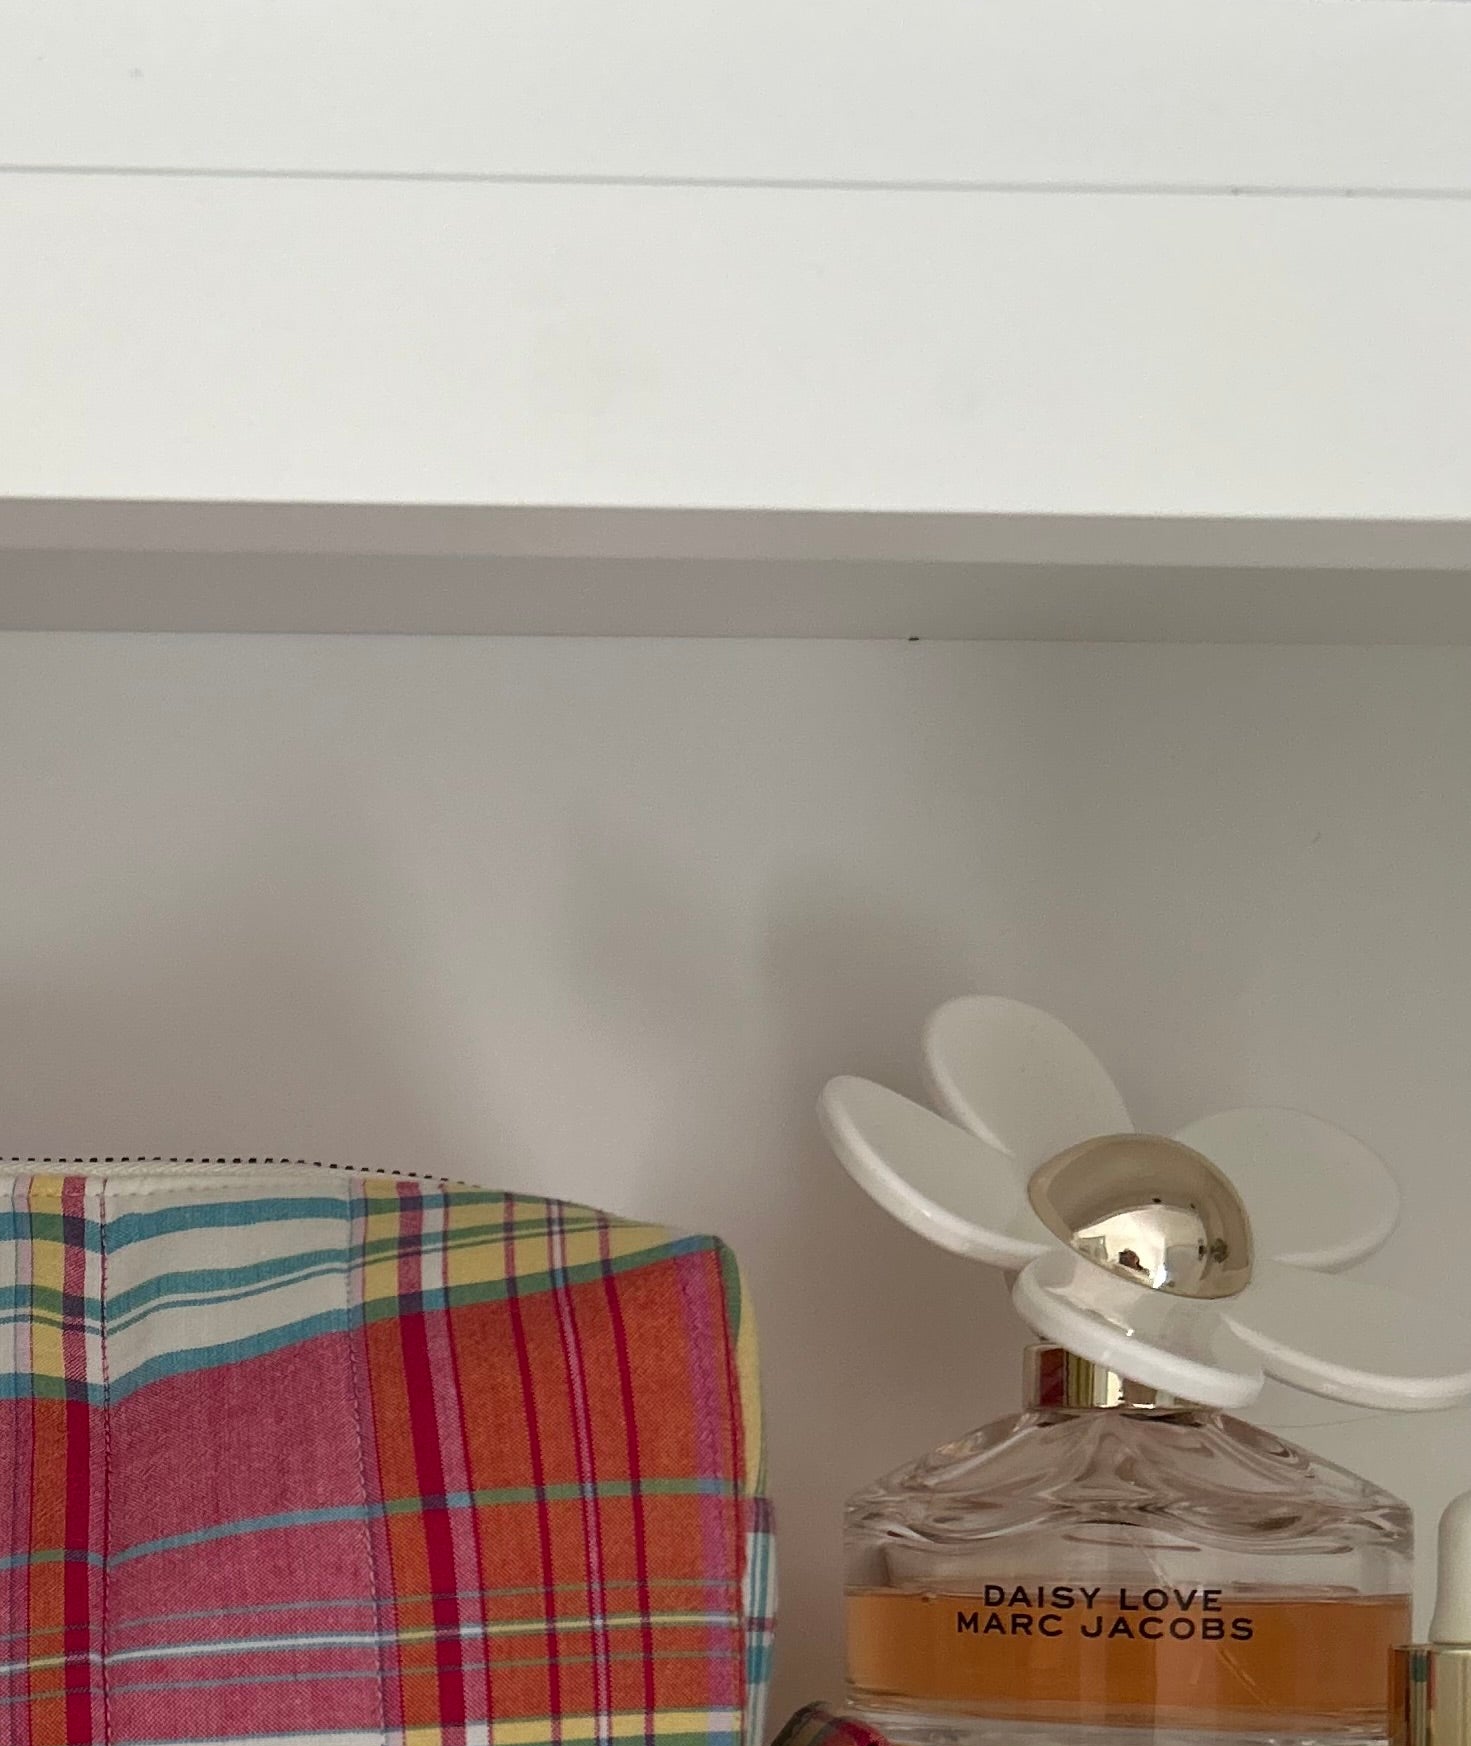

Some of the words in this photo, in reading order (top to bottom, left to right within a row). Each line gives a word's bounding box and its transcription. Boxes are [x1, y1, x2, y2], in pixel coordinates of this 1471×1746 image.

[983, 1585, 1101, 1609] DAISY
[1119, 1588, 1223, 1612] LOVE
[957, 1611, 1063, 1637] MARC
[1080, 1616, 1254, 1641] JACOBS
